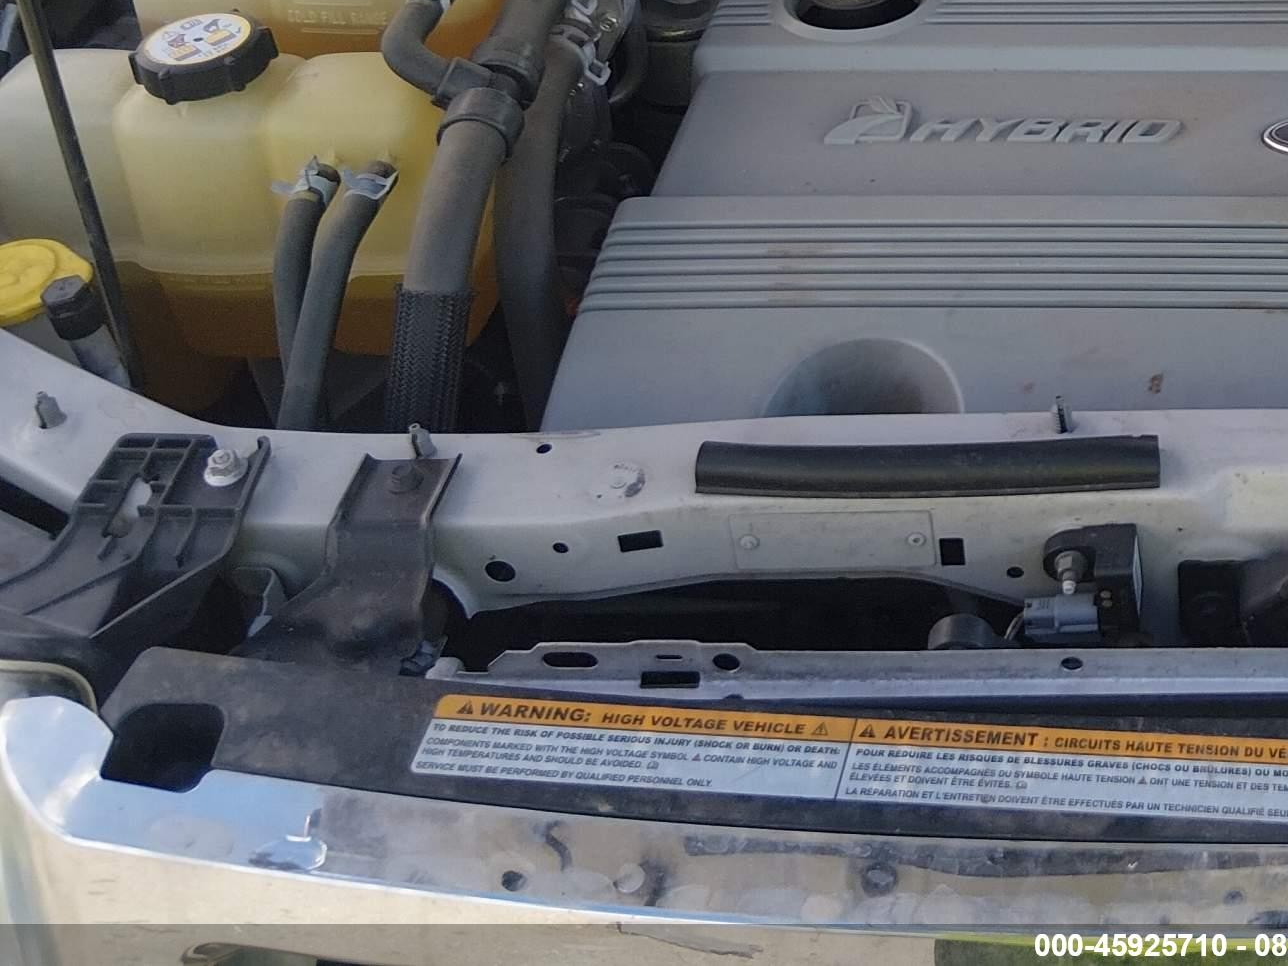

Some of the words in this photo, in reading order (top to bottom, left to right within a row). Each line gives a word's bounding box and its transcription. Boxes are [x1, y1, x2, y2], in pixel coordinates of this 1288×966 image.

[909, 118, 1182, 143] HYBRID
[480, 701, 590, 721] WARNING:
[601, 709, 646, 725] HIGH
[651, 716, 725, 729] VOLTAGE
[733, 721, 805, 734] VEHICLE
[426, 736, 489, 748] COMPONENTS
[493, 740, 532, 751] MARKED
[535, 743, 557, 752] WITH
[561, 745, 576, 753] THE
[580, 746, 602, 755] HIGH
[606, 748, 646, 758] VOLTAGE
[650, 750, 687, 760] SYMBOL
[703, 753, 744, 763] CONTAIN
[747, 756, 769, 765] HIGH
[772, 757, 814, 767] VOLTAGE
[818, 760, 837, 769] AND
[433, 723, 445, 731] TO
[448, 724, 487, 734] REDUCE
[491, 727, 510, 735] THE
[513, 728, 536, 737] RISK
[540, 730, 553, 738] OF
[556, 731, 604, 741] POSSIBLE
[607, 734, 650, 744] SERIOUS
[654, 737, 691, 746] INJURY
[694, 739, 732, 748] (SHOCK
[735, 741, 749, 749] OR
[752, 742, 784, 751] BURN)
[787, 744, 800, 752] OR
[804, 745, 840, 754] DEATH:
[884, 725, 1039, 747] AVERTISSEMENT
[1054, 734, 1120, 750] CIRCUITS
[1125, 739, 1172, 753] HAUTE
[1179, 741, 1239, 757] TENSION
[1244, 745, 1263, 758] DU
[422, 746, 444, 755] HIGH
[447, 748, 519, 760] TEMPERATURES
[523, 753, 543, 762] AND
[545, 755, 582, 765] SHOULD
[585, 757, 597, 766] BE
[855, 747, 884, 757] POUR
[936, 751, 955, 761] LES
[959, 752, 1003, 763] RISQUES
[1008, 755, 1019, 764] DE
[1023, 755, 1083, 768] BLESSURES
[1087, 759, 1128, 769] GRAVES
[1131, 760, 1170, 771] (CHOCS
[1174, 763, 1189, 772] OU
[1255, 767, 1269, 777] OU
[415, 760, 455, 771] SERVICE
[458, 763, 482, 773] MUST
[485, 765, 497, 774] BE
[500, 766, 559, 778] PERFORMED
[561, 770, 572, 779] BY
[576, 771, 624, 782] QUALIFIED
[627, 773, 682, 785] PERSONNEL
[849, 770, 891, 782] ÉLEVÉES
[894, 773, 904, 783] ET
[907, 773, 947, 785] DOIVENT
[951, 776, 974, 786] ÊTRE
[851, 760, 870, 770] LES
[872, 761, 921, 773] ÉLÉMENTS
[998, 768, 1010, 778] DU
[1014, 769, 1057, 780] SYMBOLE
[1061, 771, 1091, 782] HAUTE
[1095, 773, 1136, 784] TENSION
[1149, 776, 1167, 786] ONT
[1172, 777, 1190, 787] UNE
[1194, 778, 1233, 789] TENSION
[1236, 780, 1247, 790] ET
[1250, 781, 1268, 791] DES
[845, 785, 857, 795] LA
[860, 786, 919, 799] RÉPARATION
[922, 789, 934, 799] ET
[935, 790, 995, 803] L'ENTRETIEN
[998, 794, 1037, 805] DOIVENT
[1041, 796, 1064, 807] ÊTRE
[1068, 797, 1123, 809] EFFECTUÉS
[1125, 800, 1144, 810] PAR
[1147, 801, 1159, 811] UN
[1163, 802, 1218, 814] TECHNICIEN
[1222, 805, 1263, 816] QUALIFIÉ
